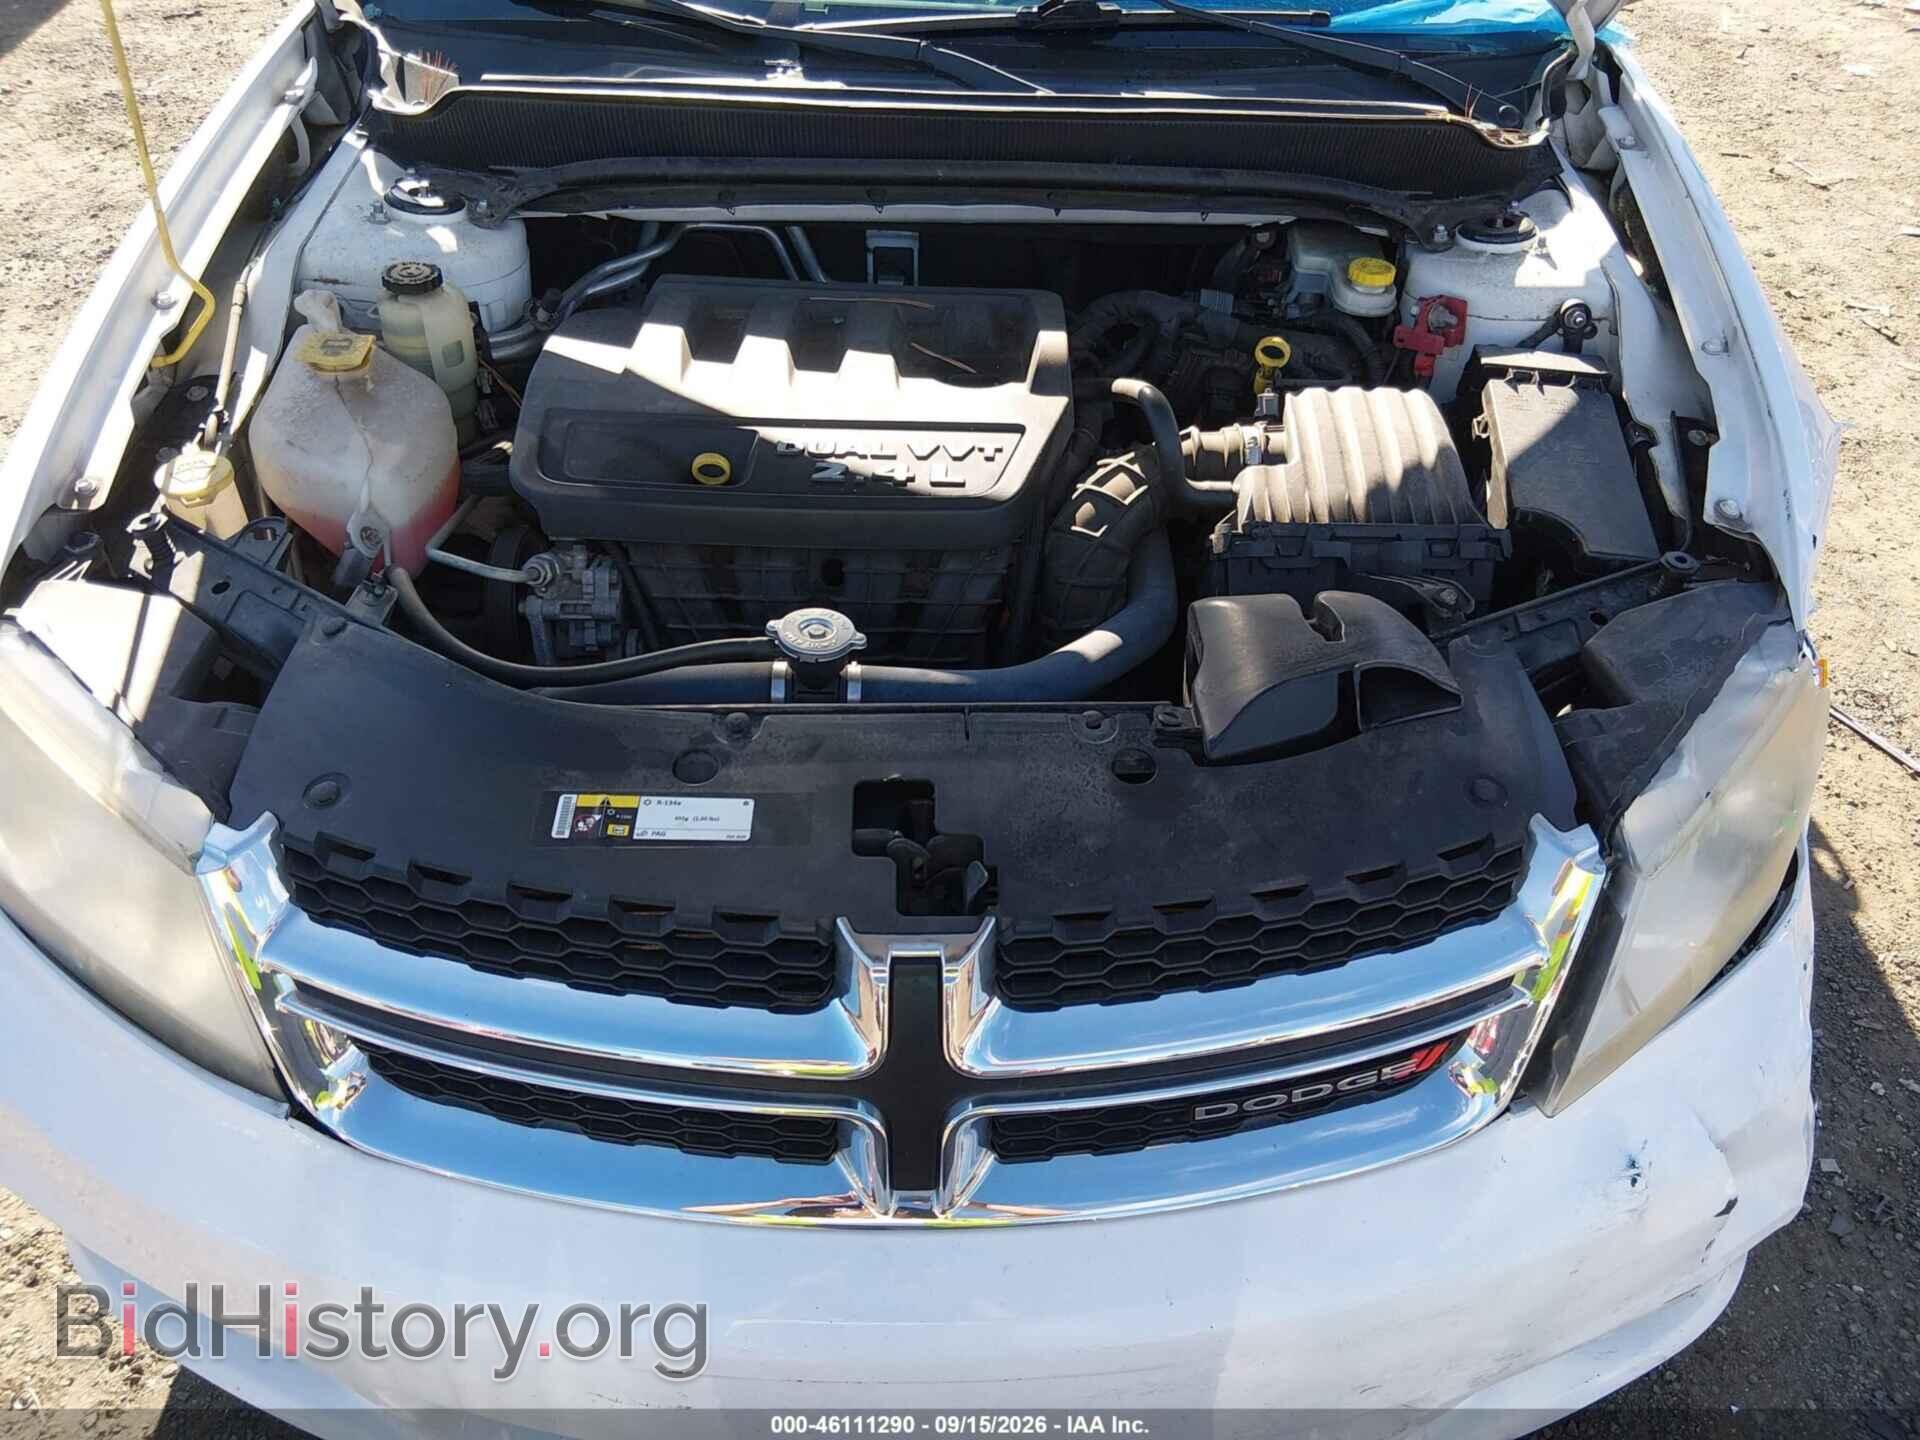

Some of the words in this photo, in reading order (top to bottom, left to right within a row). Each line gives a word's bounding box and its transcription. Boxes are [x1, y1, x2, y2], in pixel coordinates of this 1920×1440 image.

[776, 439, 897, 460] DUAL
[907, 443, 1003, 462] VVT
[1194, 1058, 1418, 1121] DODGE
